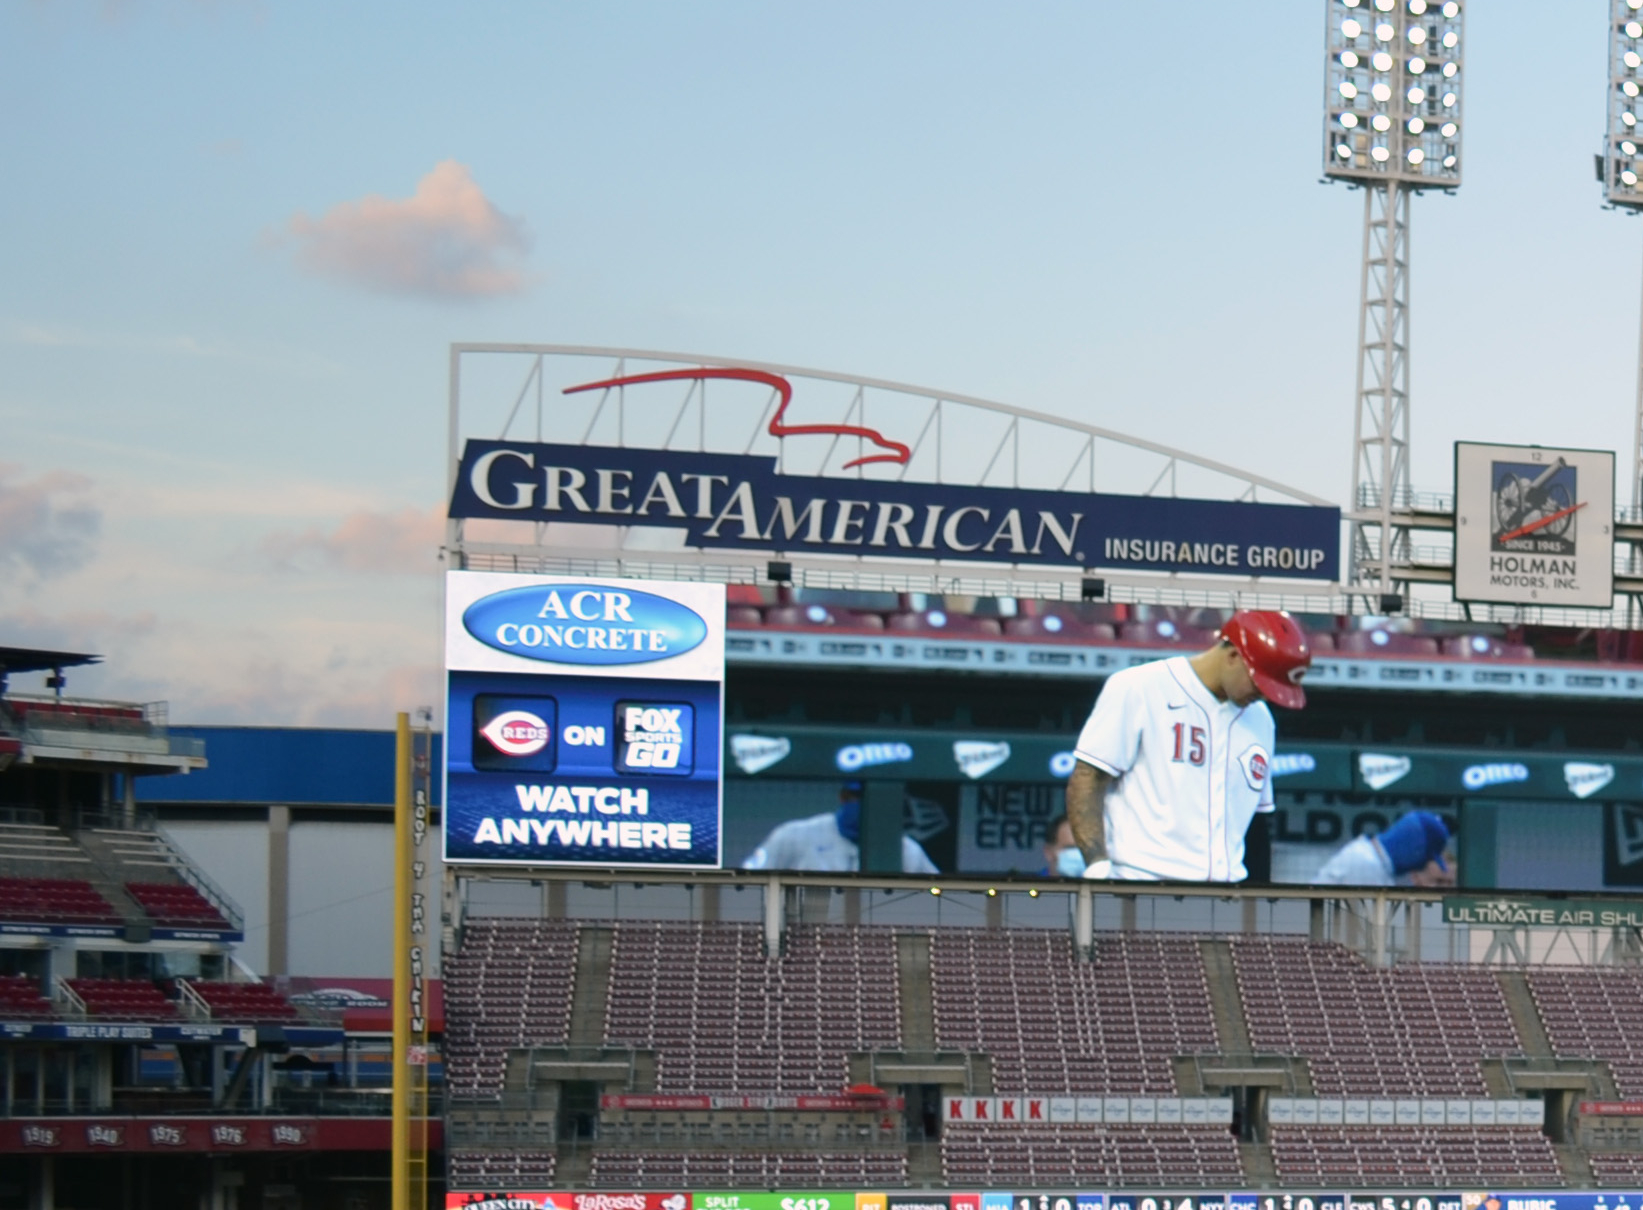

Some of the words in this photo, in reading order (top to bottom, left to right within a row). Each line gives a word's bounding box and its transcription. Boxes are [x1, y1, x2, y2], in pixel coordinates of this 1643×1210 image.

[470, 448, 728, 521] GREAT
[704, 481, 1084, 557] AMERICAN
[1105, 537, 1239, 567] INSURANCE
[1247, 545, 1325, 571] GROUP
[1490, 556, 1576, 576] HOLMAN
[1490, 575, 1548, 589] MOTORS,
[1553, 577, 1579, 590] INC.
[537, 589, 633, 624] ACR
[497, 622, 668, 653] CONCRETE
[625, 708, 680, 734] FOX
[563, 724, 605, 748] ON
[625, 730, 683, 745] SPORTS
[1172, 722, 1207, 767] 15
[626, 742, 680, 768] GO
[516, 786, 649, 815] WATCH
[473, 818, 692, 850] ANYWHERE
[1449, 906, 1555, 925] ULTIMATE
[1560, 909, 1595, 926] AIR
[99, 1026, 123, 1039] PLAY
[950, 1101, 963, 1119] K
[975, 1101, 988, 1119] K
[1002, 1101, 1015, 1119] K
[1029, 1101, 1042, 1119] K
[152, 1127, 180, 1143] 1975
[213, 1127, 242, 1143] 1976
[705, 1196, 739, 1208] SPLIT
